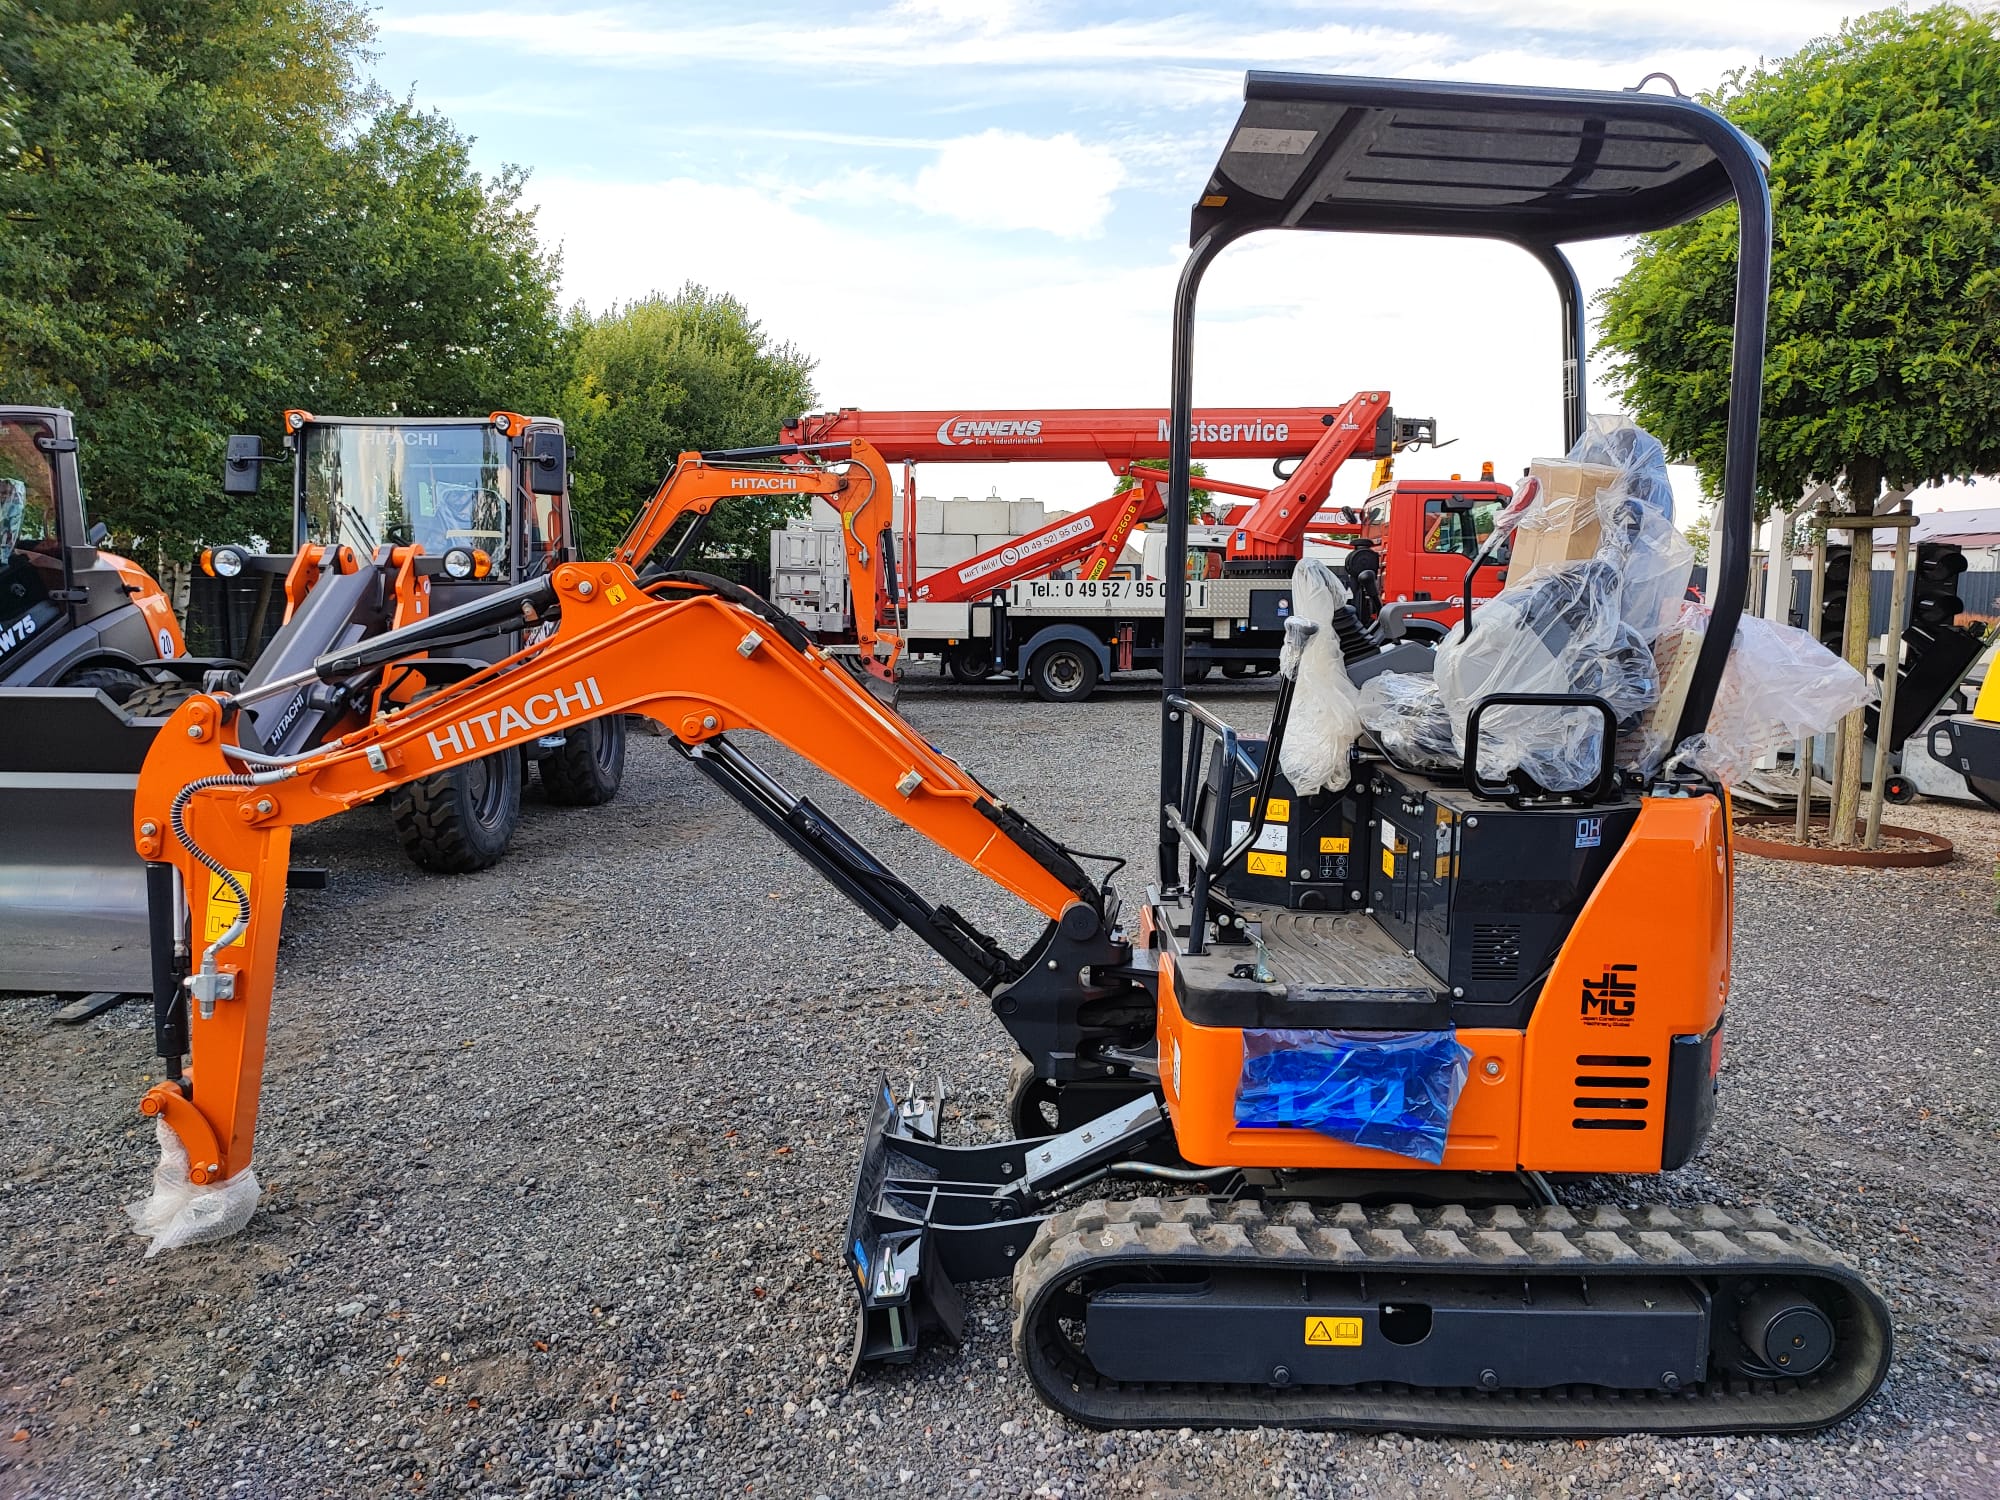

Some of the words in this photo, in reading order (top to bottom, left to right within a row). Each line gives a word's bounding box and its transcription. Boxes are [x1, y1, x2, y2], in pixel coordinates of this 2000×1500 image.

[362, 432, 438, 446] HITACHI
[1157, 418, 1289, 442] Metservice
[731, 478, 797, 490] HITACHI
[1111, 534, 1119, 543] P
[1116, 513, 1132, 534] 260
[1127, 505, 1137, 514] B
[1031, 540, 1042, 550] 49
[1059, 528, 1071, 538] 95
[1030, 582, 1060, 597] Tel.:
[1065, 582, 1074, 597] 0
[1079, 582, 1097, 597] 49
[1102, 582, 1120, 597] 52
[1124, 582, 1132, 599] /
[1136, 582, 1154, 597] 95
[0, 614, 36, 657] W75
[161, 634, 172, 655] 20
[271, 693, 305, 746] HITACHI
[426, 676, 604, 761] HITACHI
